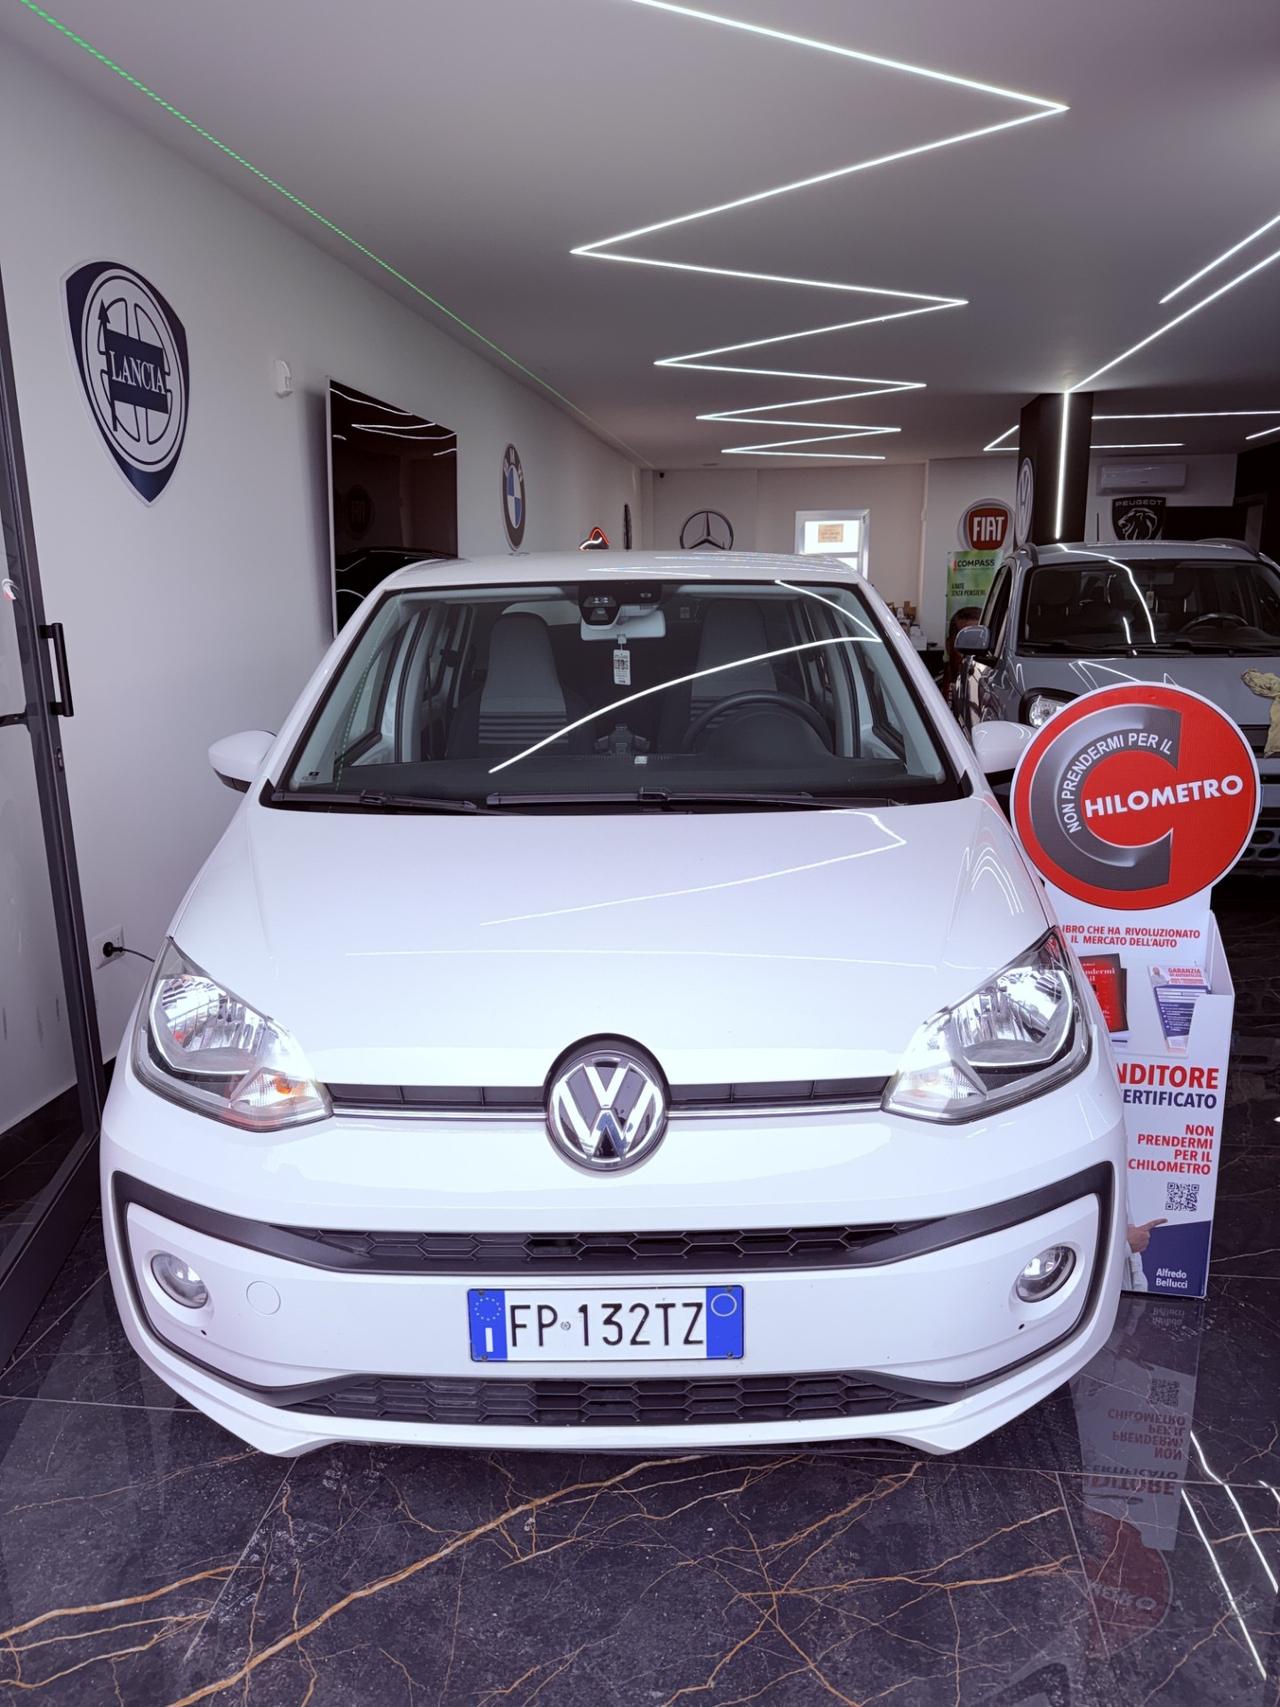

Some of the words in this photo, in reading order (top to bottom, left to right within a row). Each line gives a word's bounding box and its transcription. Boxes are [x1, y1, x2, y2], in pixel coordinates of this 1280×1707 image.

[109, 350, 167, 395] LANCIA
[973, 516, 1005, 542] FIAT
[957, 559, 995, 568] COMPASS
[1128, 733, 1159, 749] PER
[1159, 738, 1174, 755] IL
[1062, 734, 1124, 799] PRENDERMI
[1062, 804, 1082, 833] NON
[1062, 924, 1085, 934] IBRO
[1087, 925, 1105, 935] CHE
[1107, 926, 1121, 935] HA
[1125, 927, 1201, 939] RIVOLUZIONATO
[1071, 935, 1079, 944] IL
[1083, 936, 1127, 946] MERCATO
[1129, 937, 1178, 948] DELL'AUTO
[1085, 967, 1115, 976] ndermi
[1117, 1063, 1219, 1089] NDITORE
[1122, 1088, 1217, 1109] ERTIFICATO
[1185, 1124, 1214, 1137] NON
[1137, 1134, 1213, 1150] PRENDERMI
[1174, 1149, 1198, 1161] PER
[1201, 1151, 1212, 1162] IL
[1128, 1158, 1211, 1175] CHILOMETRO
[1156, 1268, 1187, 1278] Alfredo
[1156, 1278, 1188, 1288] Bellucci
[485, 1327, 494, 1352] I
